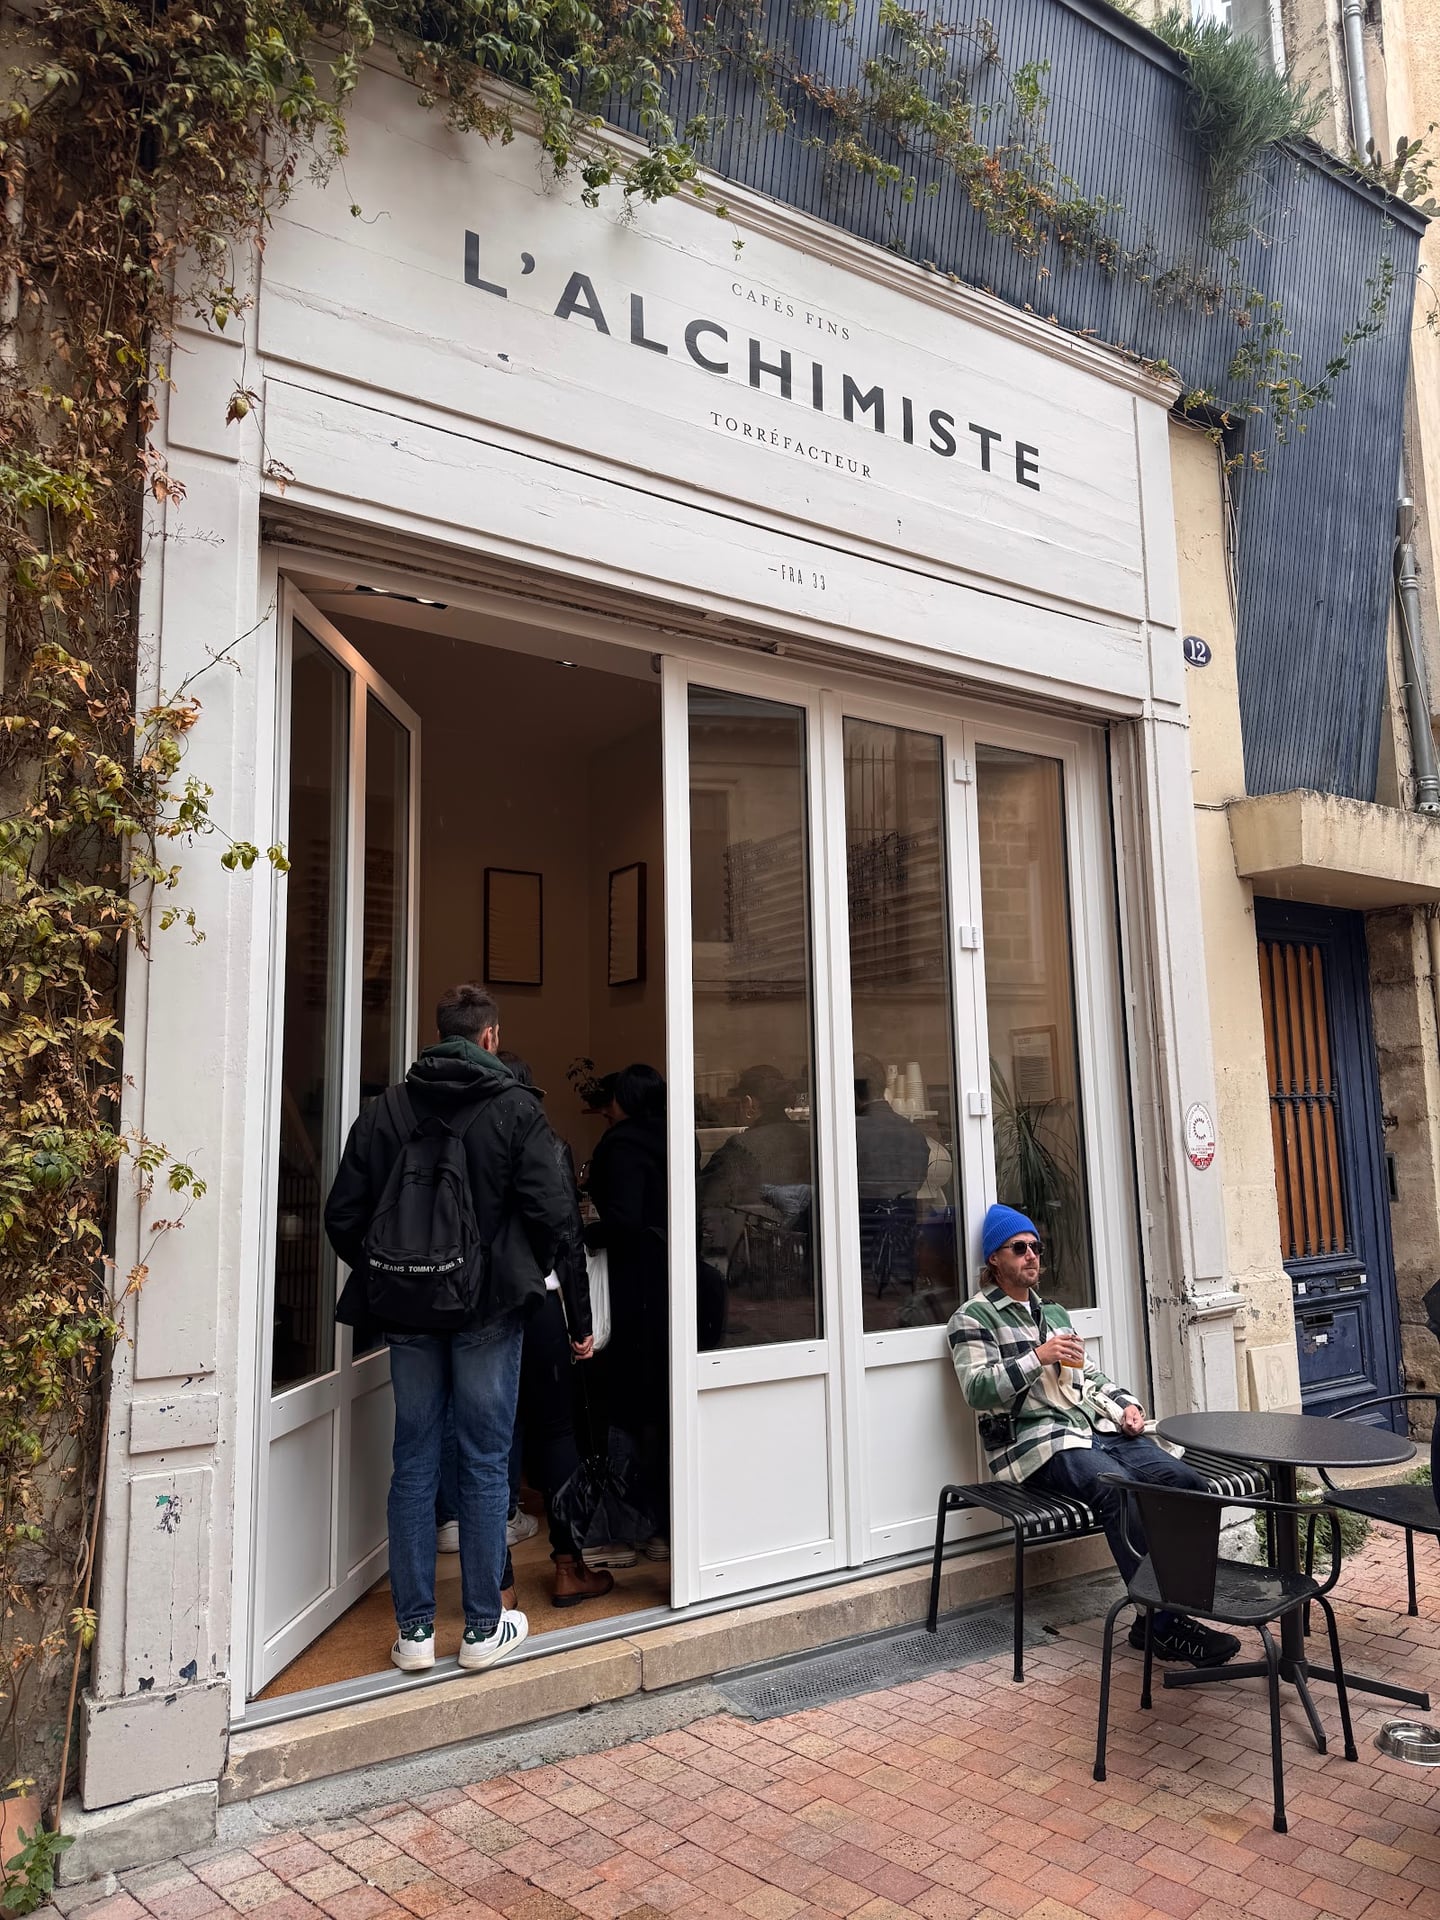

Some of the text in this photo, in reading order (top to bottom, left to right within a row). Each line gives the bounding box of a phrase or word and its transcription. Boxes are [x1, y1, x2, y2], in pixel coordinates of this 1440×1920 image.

[731, 282, 852, 341] CAFÉS FINS
[464, 229, 1041, 492] L'ALCHIMISTE
[710, 411, 872, 479] TORRÉFACTEUR
[812, 573, 826, 591] 33
[1188, 639, 1206, 662] 12
[382, 1264, 404, 1272] JEANS
[408, 1265, 435, 1273] TOMMY
[436, 1261, 455, 1272] JEANS
